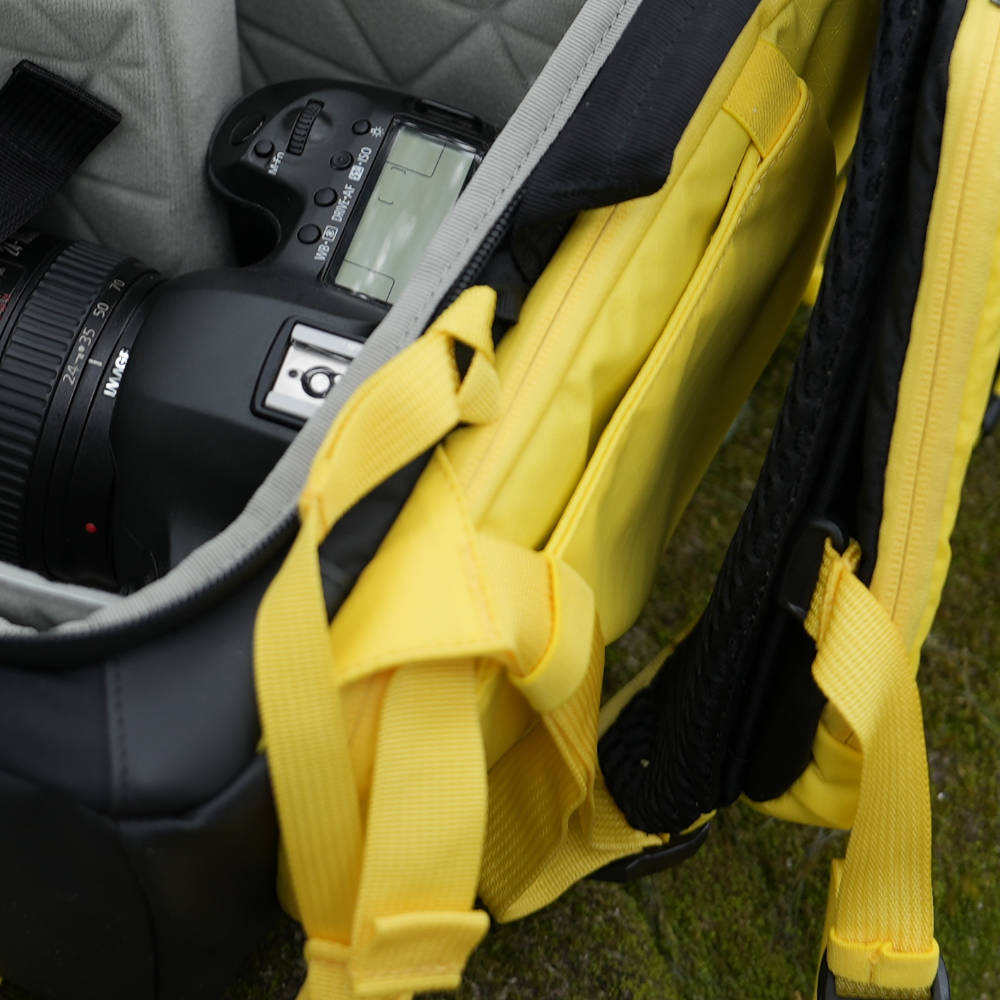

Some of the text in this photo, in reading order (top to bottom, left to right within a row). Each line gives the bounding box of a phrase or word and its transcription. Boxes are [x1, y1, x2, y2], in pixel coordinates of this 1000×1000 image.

[80, 327, 97, 347] 35
[93, 301, 110, 319] 50
[109, 278, 126, 291] 70
